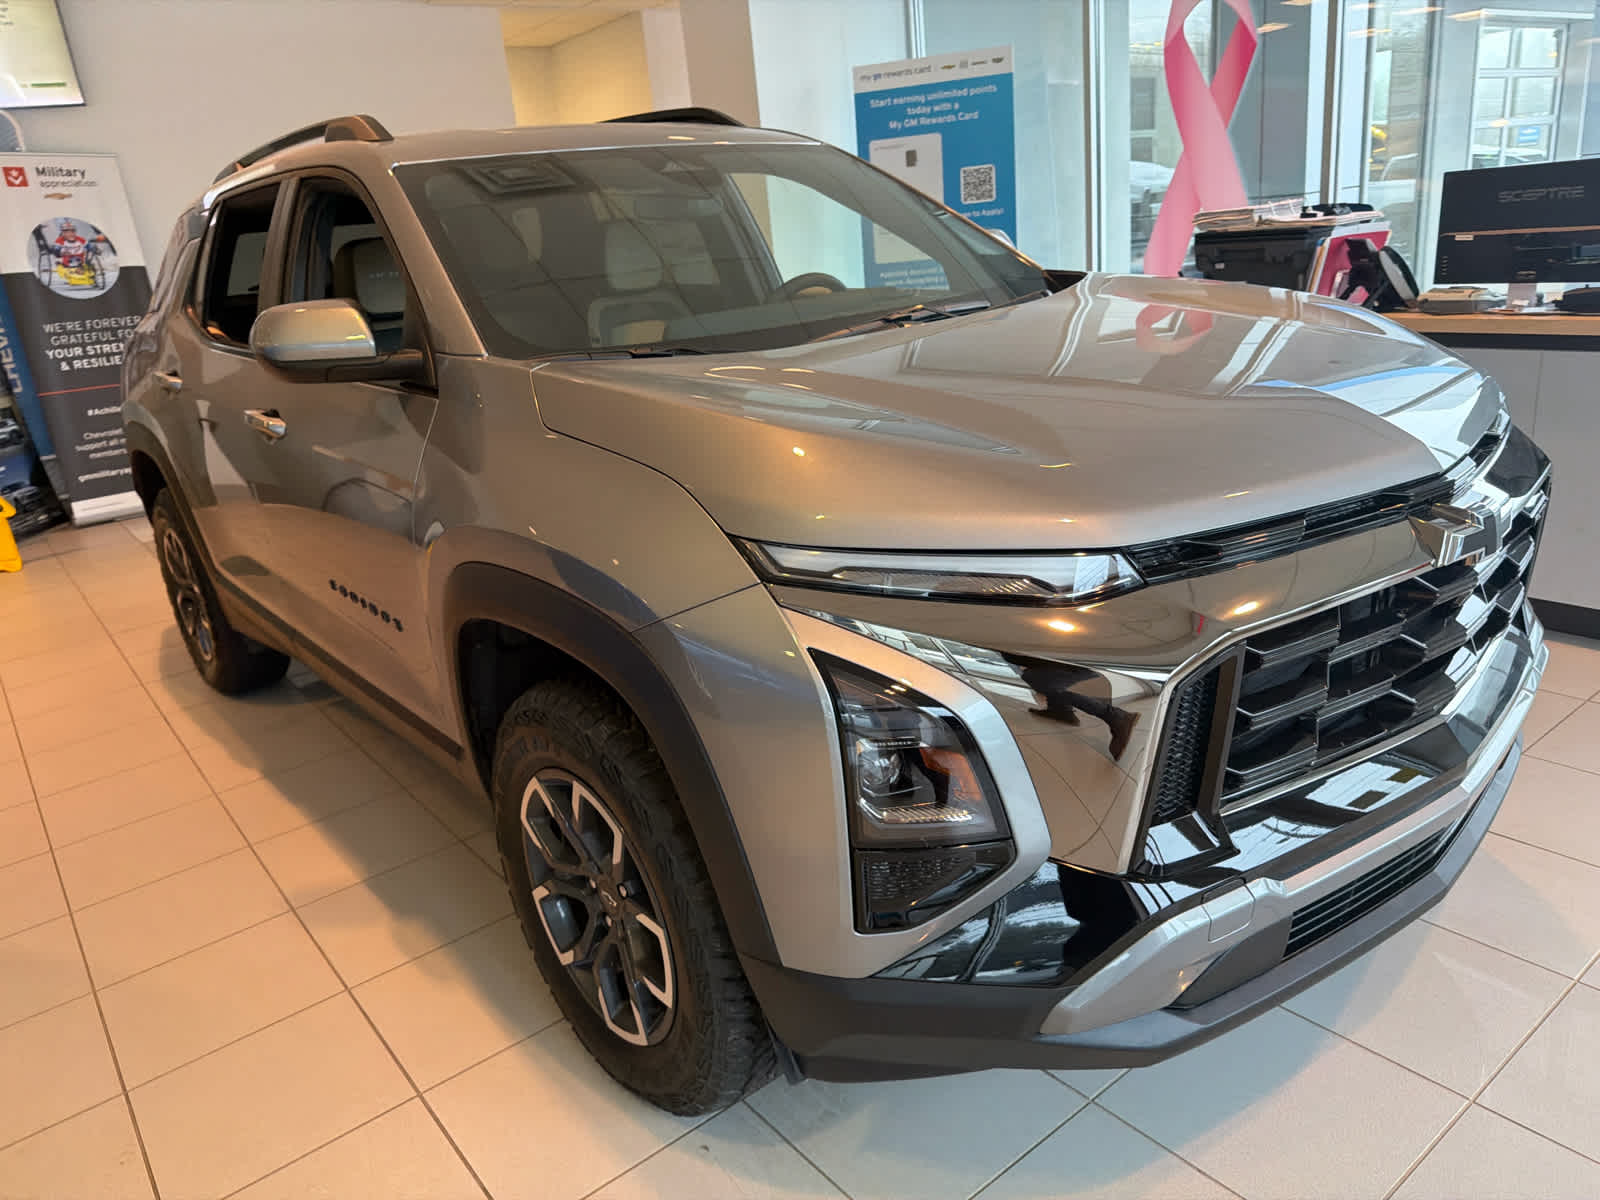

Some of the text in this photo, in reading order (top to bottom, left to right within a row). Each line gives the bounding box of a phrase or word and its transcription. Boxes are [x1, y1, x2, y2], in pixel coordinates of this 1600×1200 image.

[869, 84, 998, 108] Start earning unlimited points
[906, 105, 931, 115] today
[933, 102, 953, 112] with
[889, 110, 979, 131] My GM Rewards Card
[34, 166, 86, 179] Military
[43, 321, 83, 334] WE'RE
[50, 328, 134, 346] GRATEFUL FO
[45, 346, 84, 360] YOUR
[60, 355, 123, 371] & RESILIE
